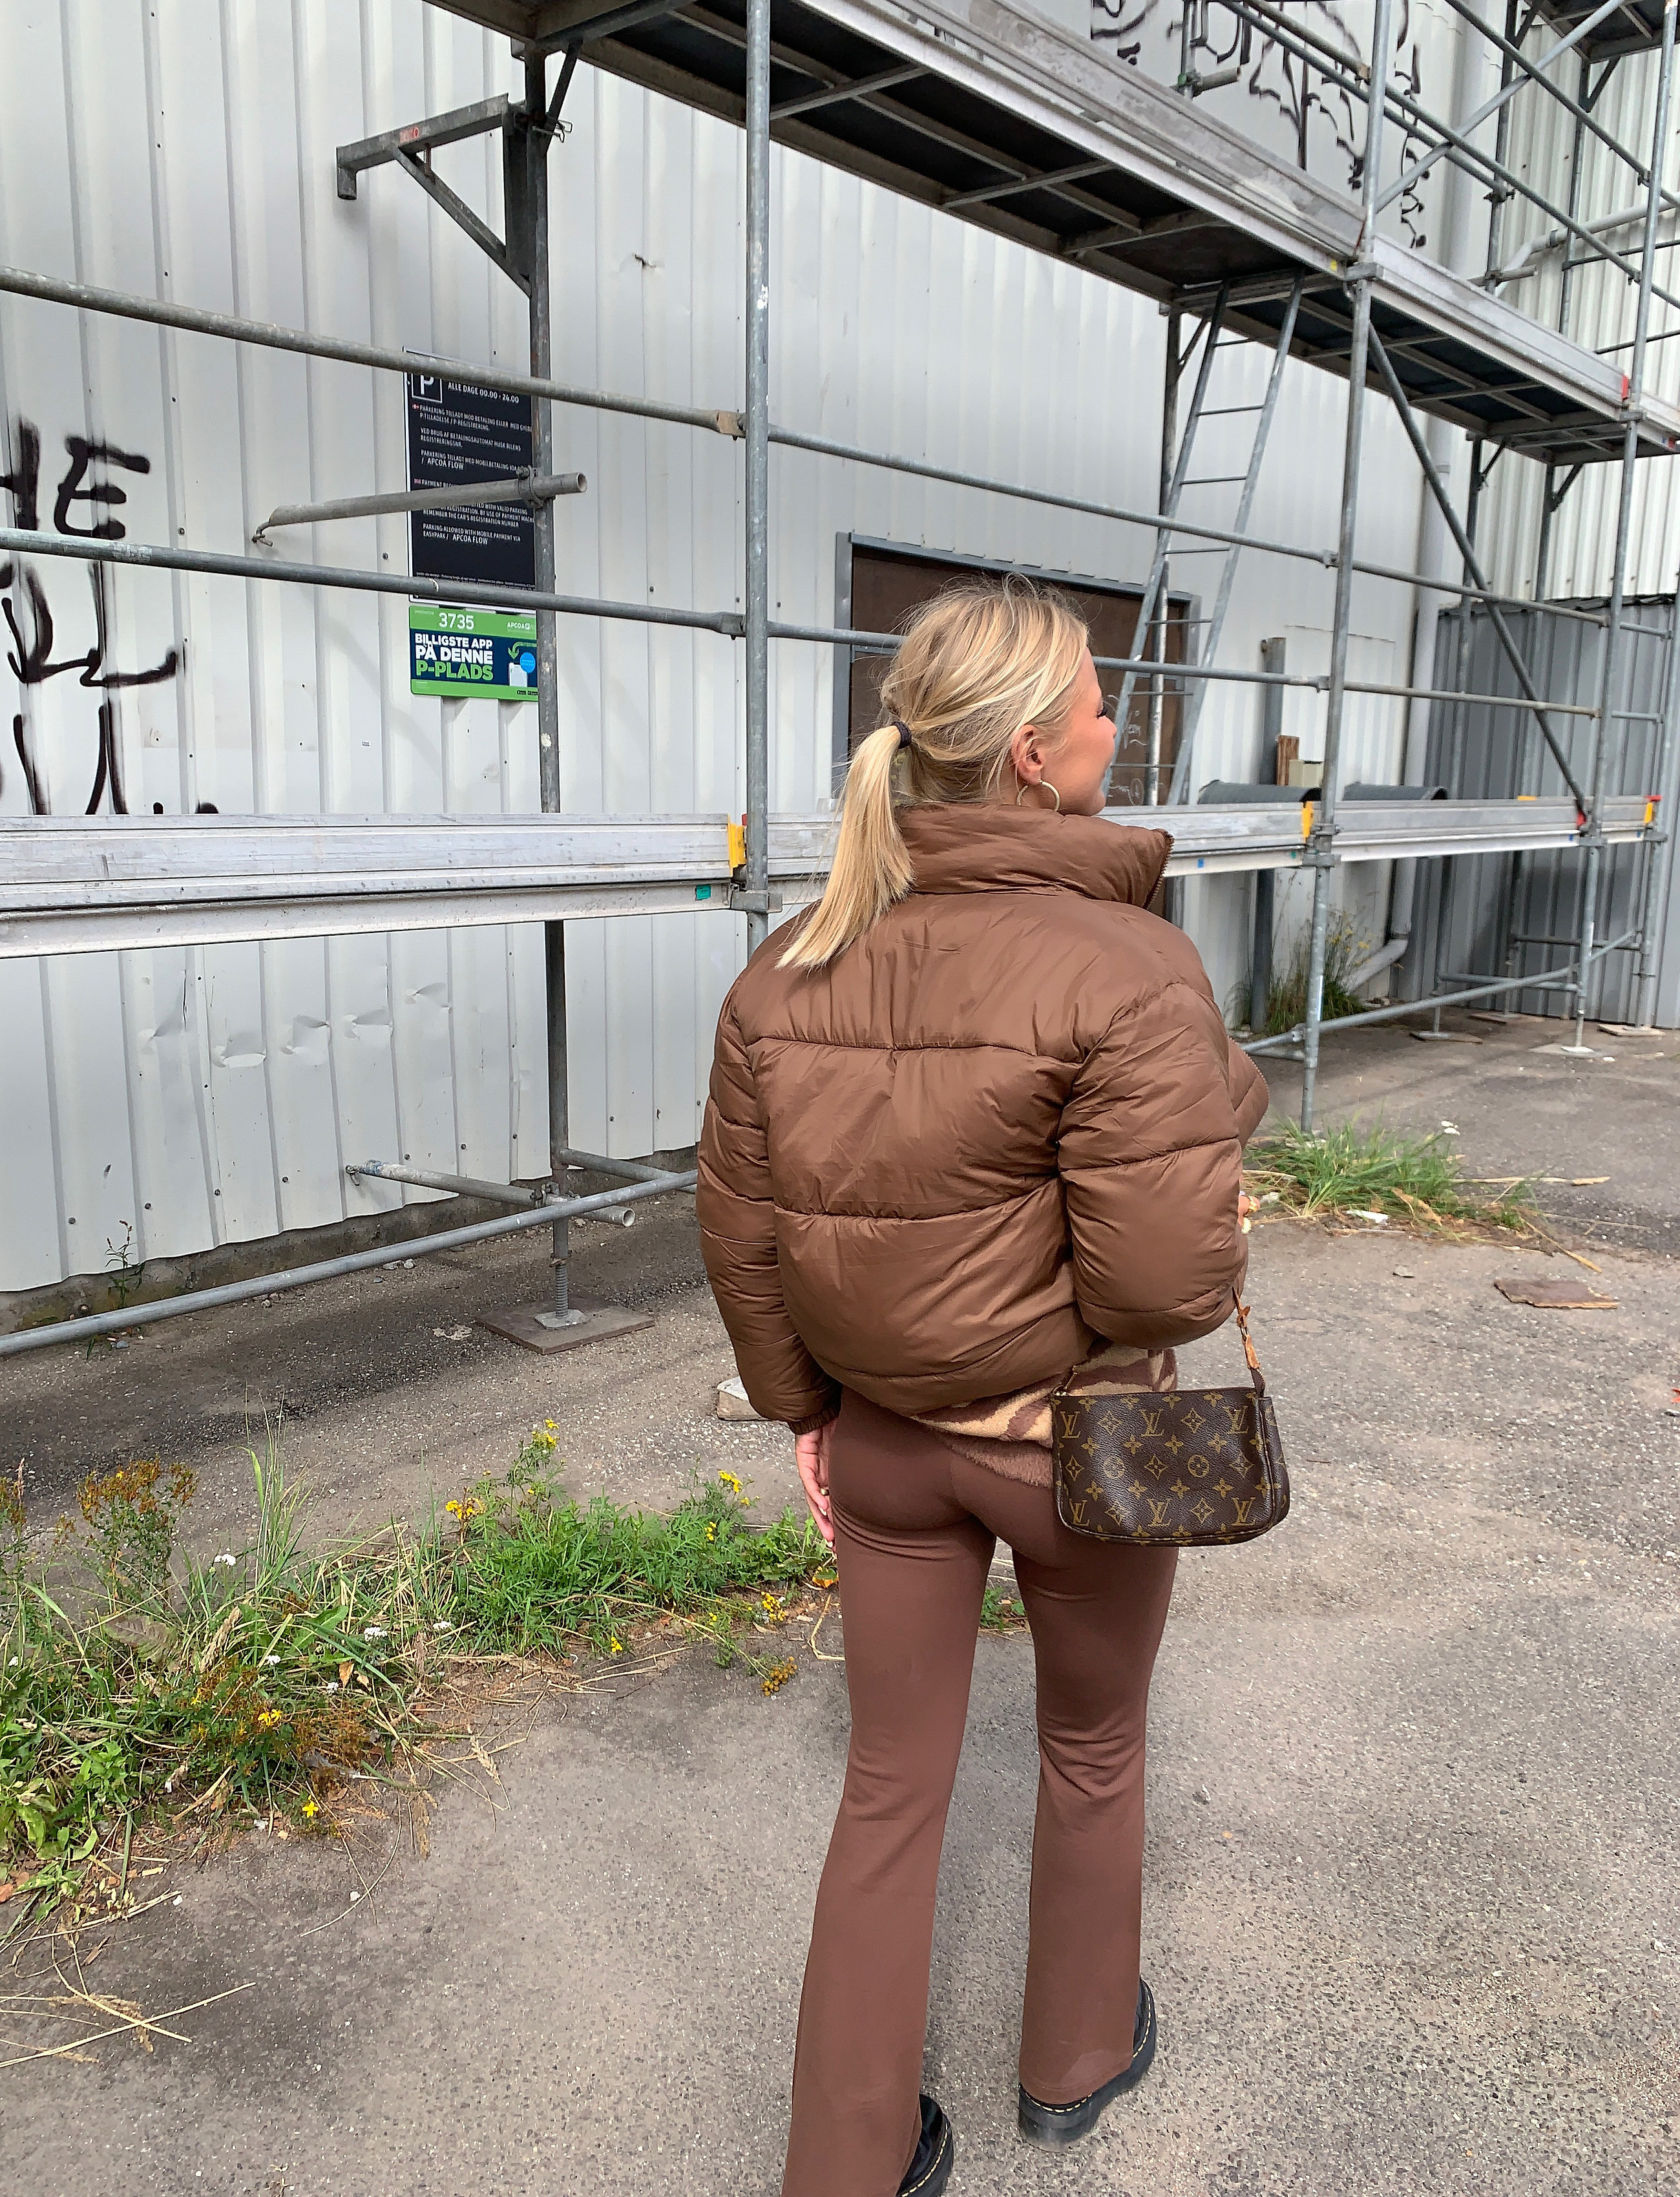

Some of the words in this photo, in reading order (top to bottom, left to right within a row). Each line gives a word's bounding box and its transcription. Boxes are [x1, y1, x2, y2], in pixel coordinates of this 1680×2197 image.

[448, 382, 461, 391] ALLE
[463, 384, 478, 394] DAGE
[479, 389, 498, 399] 00.00
[502, 394, 519, 403] 24.00
[420, 405, 445, 415] PARKERING
[475, 415, 496, 425] BETALING
[421, 449, 446, 459] PARKERING
[447, 454, 464, 462] TILLADT
[428, 457, 446, 467] APCOA
[448, 461, 464, 470] FLOW
[422, 479, 442, 488] PAYMENT
[423, 509, 448, 518] REMEMBER
[470, 516, 500, 525] REGISTRATION
[423, 523, 442, 531] PARKING
[423, 531, 445, 539] EASYPARK
[452, 534, 472, 543] APCOA
[472, 536, 488, 545] FLOW
[439, 612, 474, 630] 3735
[415, 633, 469, 648] BILLIGSTE
[471, 638, 493, 649] APP
[415, 644, 437, 660] PÅ
[440, 647, 493, 665] DENNE
[415, 660, 494, 681] P-PLADS
